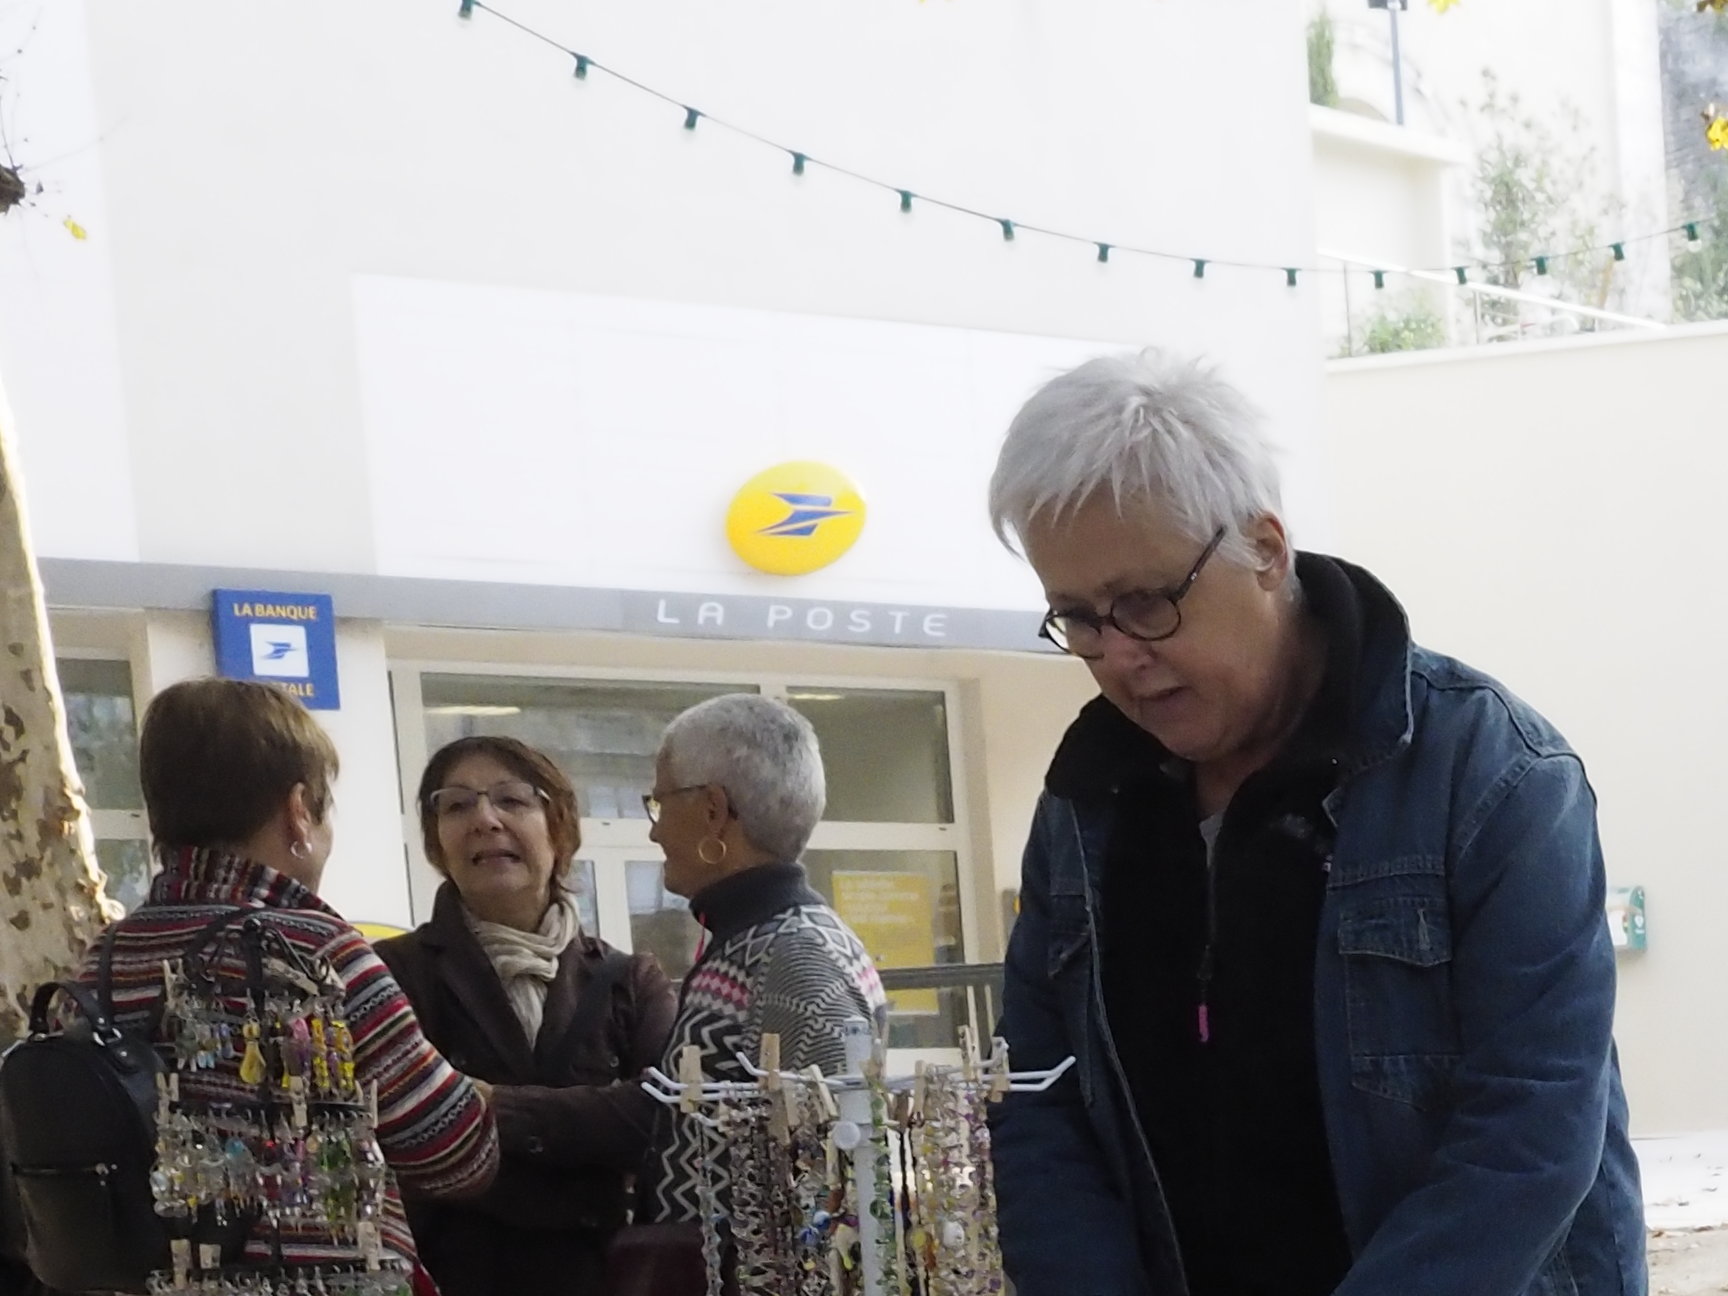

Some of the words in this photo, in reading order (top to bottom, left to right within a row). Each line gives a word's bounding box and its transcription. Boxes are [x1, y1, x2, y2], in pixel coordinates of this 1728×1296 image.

[232, 602, 253, 617] LA
[254, 603, 318, 621] BANQUE
[657, 599, 725, 626] LA
[766, 604, 948, 638] POSTE
